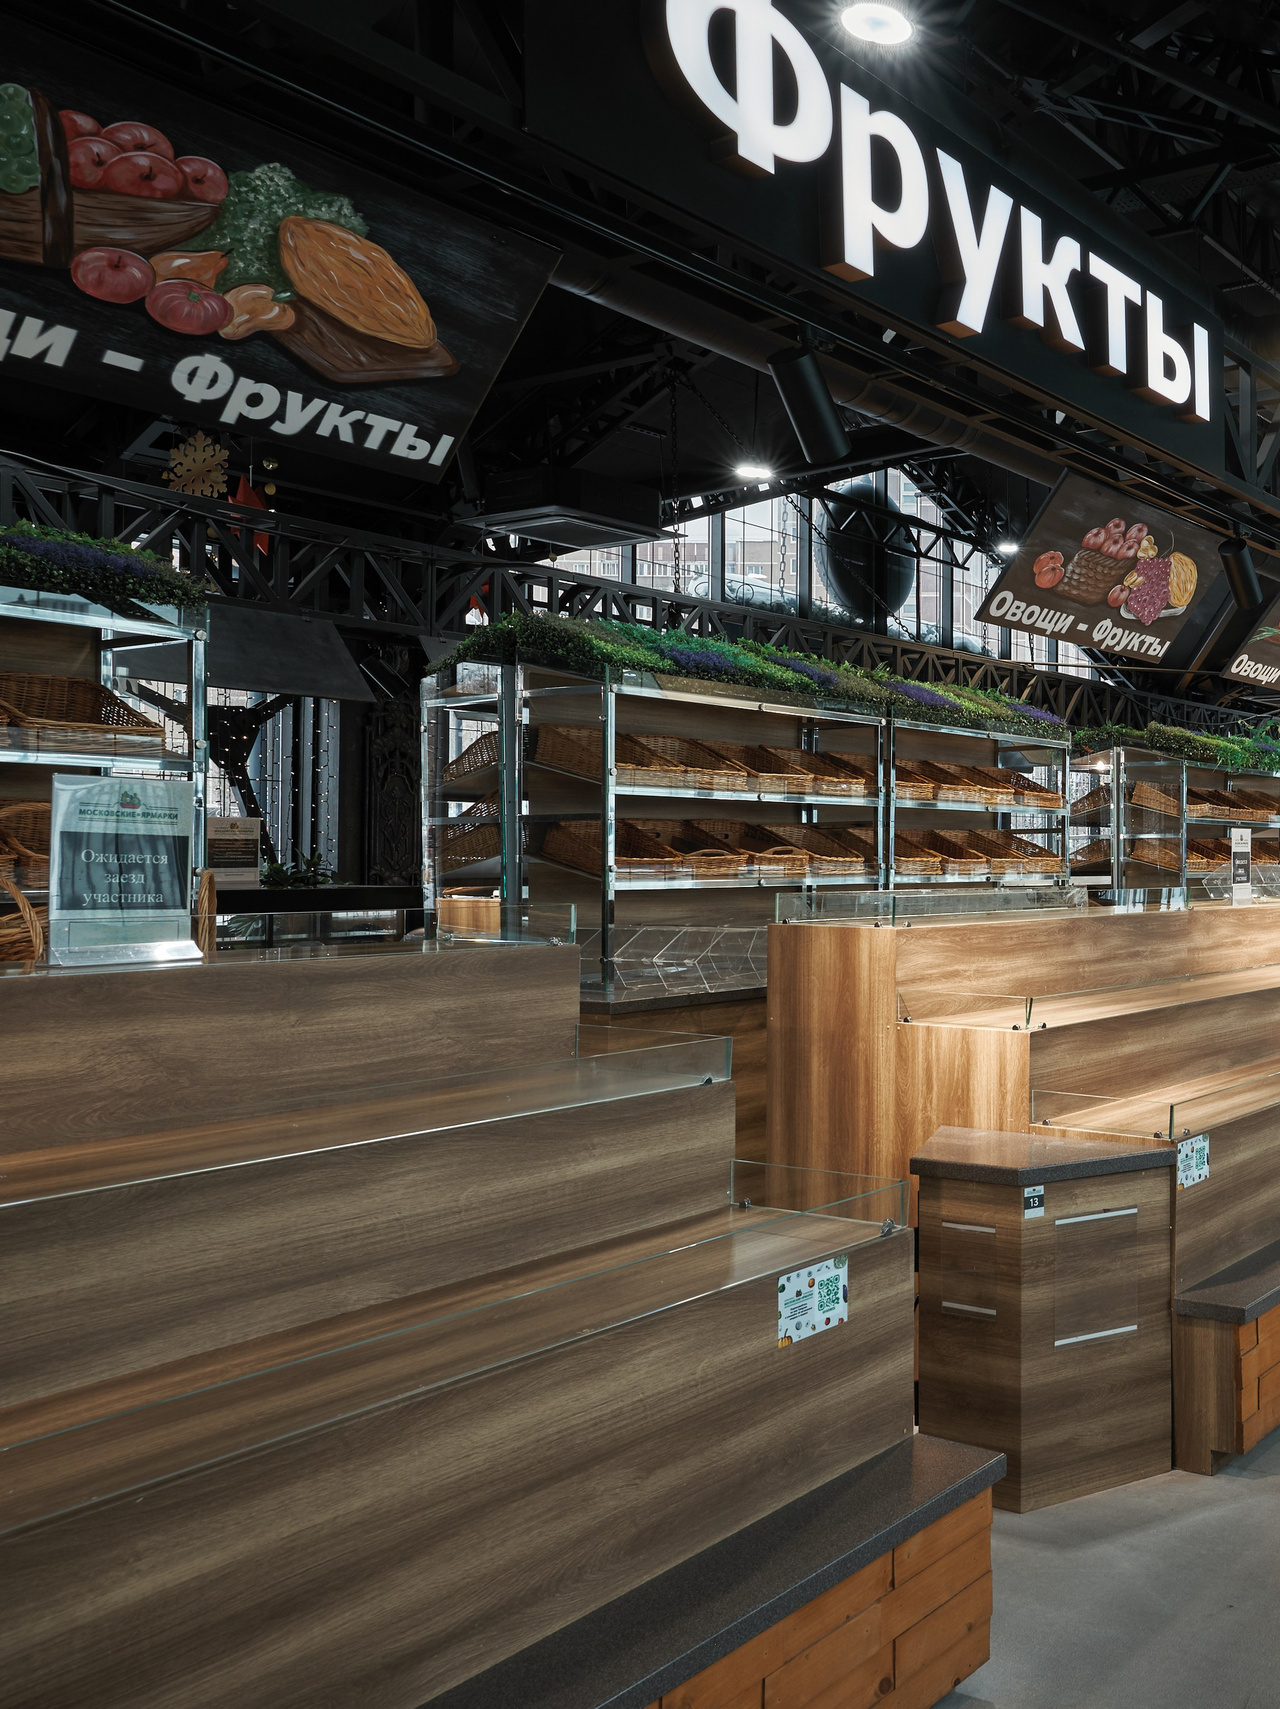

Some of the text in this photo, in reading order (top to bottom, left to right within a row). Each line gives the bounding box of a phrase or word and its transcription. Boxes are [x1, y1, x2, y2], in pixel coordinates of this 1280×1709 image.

[665, 0, 1211, 422] Фрукты
[171, 353, 455, 467] Фрукты
[988, 590, 1075, 636] Овощи
[1091, 618, 1171, 658] Фрукты
[78, 808, 178, 820] МОСКОВСКИЕ ЯРМАРКИ
[81, 848, 168, 865] Ожидается
[104, 872, 145, 885] заезд
[82, 892, 164, 906] участника
[1029, 1197, 1039, 1207] 13
